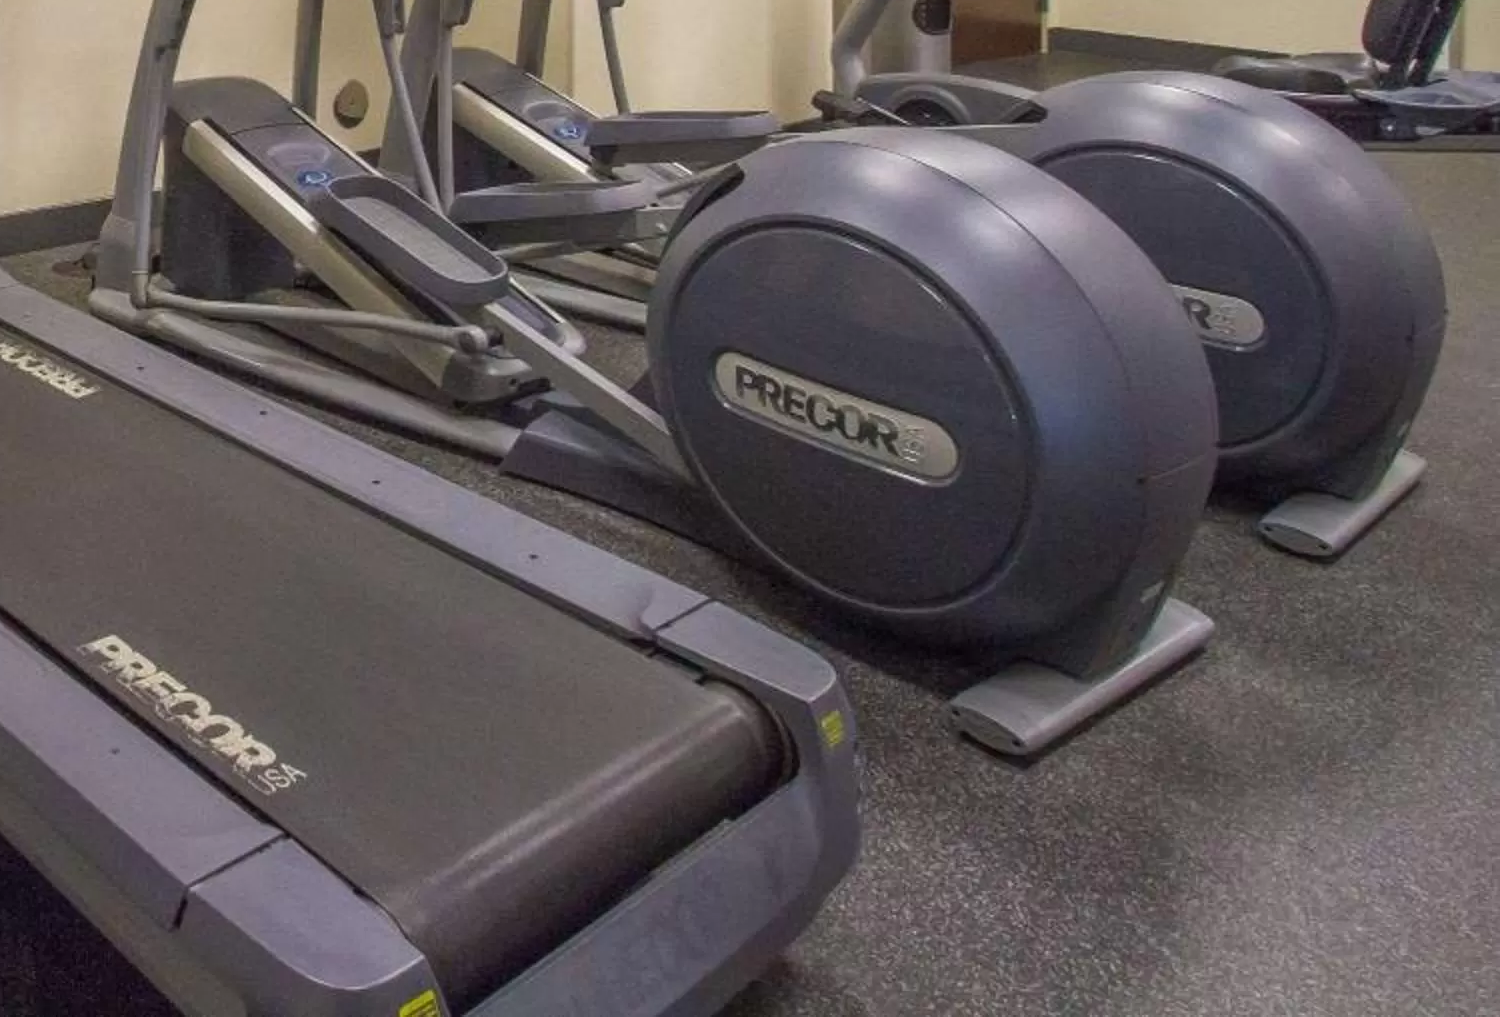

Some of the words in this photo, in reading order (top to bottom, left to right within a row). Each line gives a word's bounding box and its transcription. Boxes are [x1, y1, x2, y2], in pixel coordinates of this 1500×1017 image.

[734, 365, 904, 459] PRECOR
[76, 635, 277, 773] PRECOR
[248, 762, 308, 796] USA
